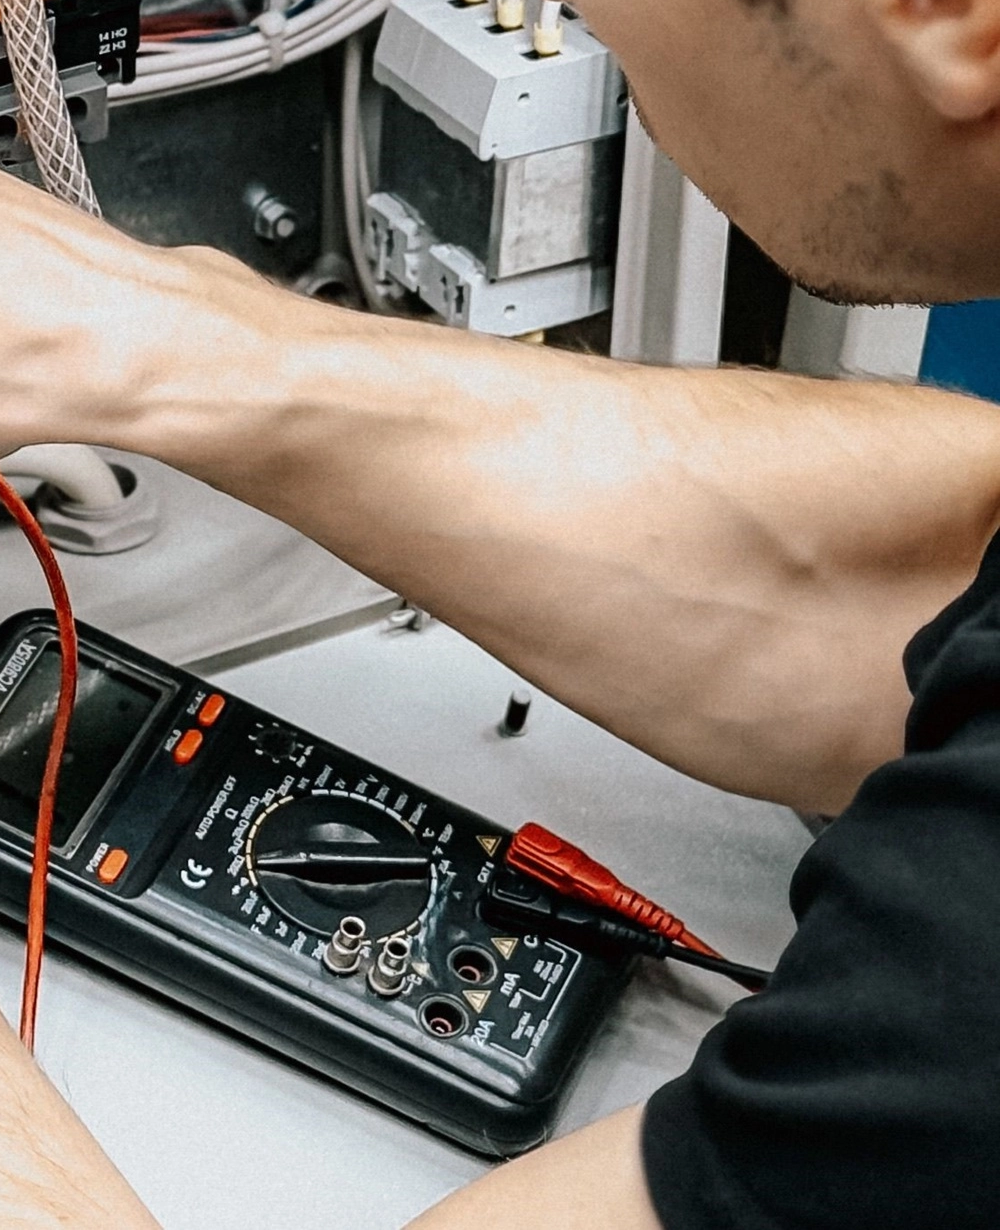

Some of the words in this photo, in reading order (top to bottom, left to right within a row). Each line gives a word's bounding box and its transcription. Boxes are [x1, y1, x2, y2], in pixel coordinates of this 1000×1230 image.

[164, 729, 182, 752] HOLD
[195, 817, 213, 840] AUTO
[207, 790, 229, 818] POWER
[223, 775, 236, 791] OFF
[86, 843, 109, 872] POWER
[181, 859, 213, 888] CE
[500, 973, 520, 996] mA
[467, 1020, 495, 1048] 20A
